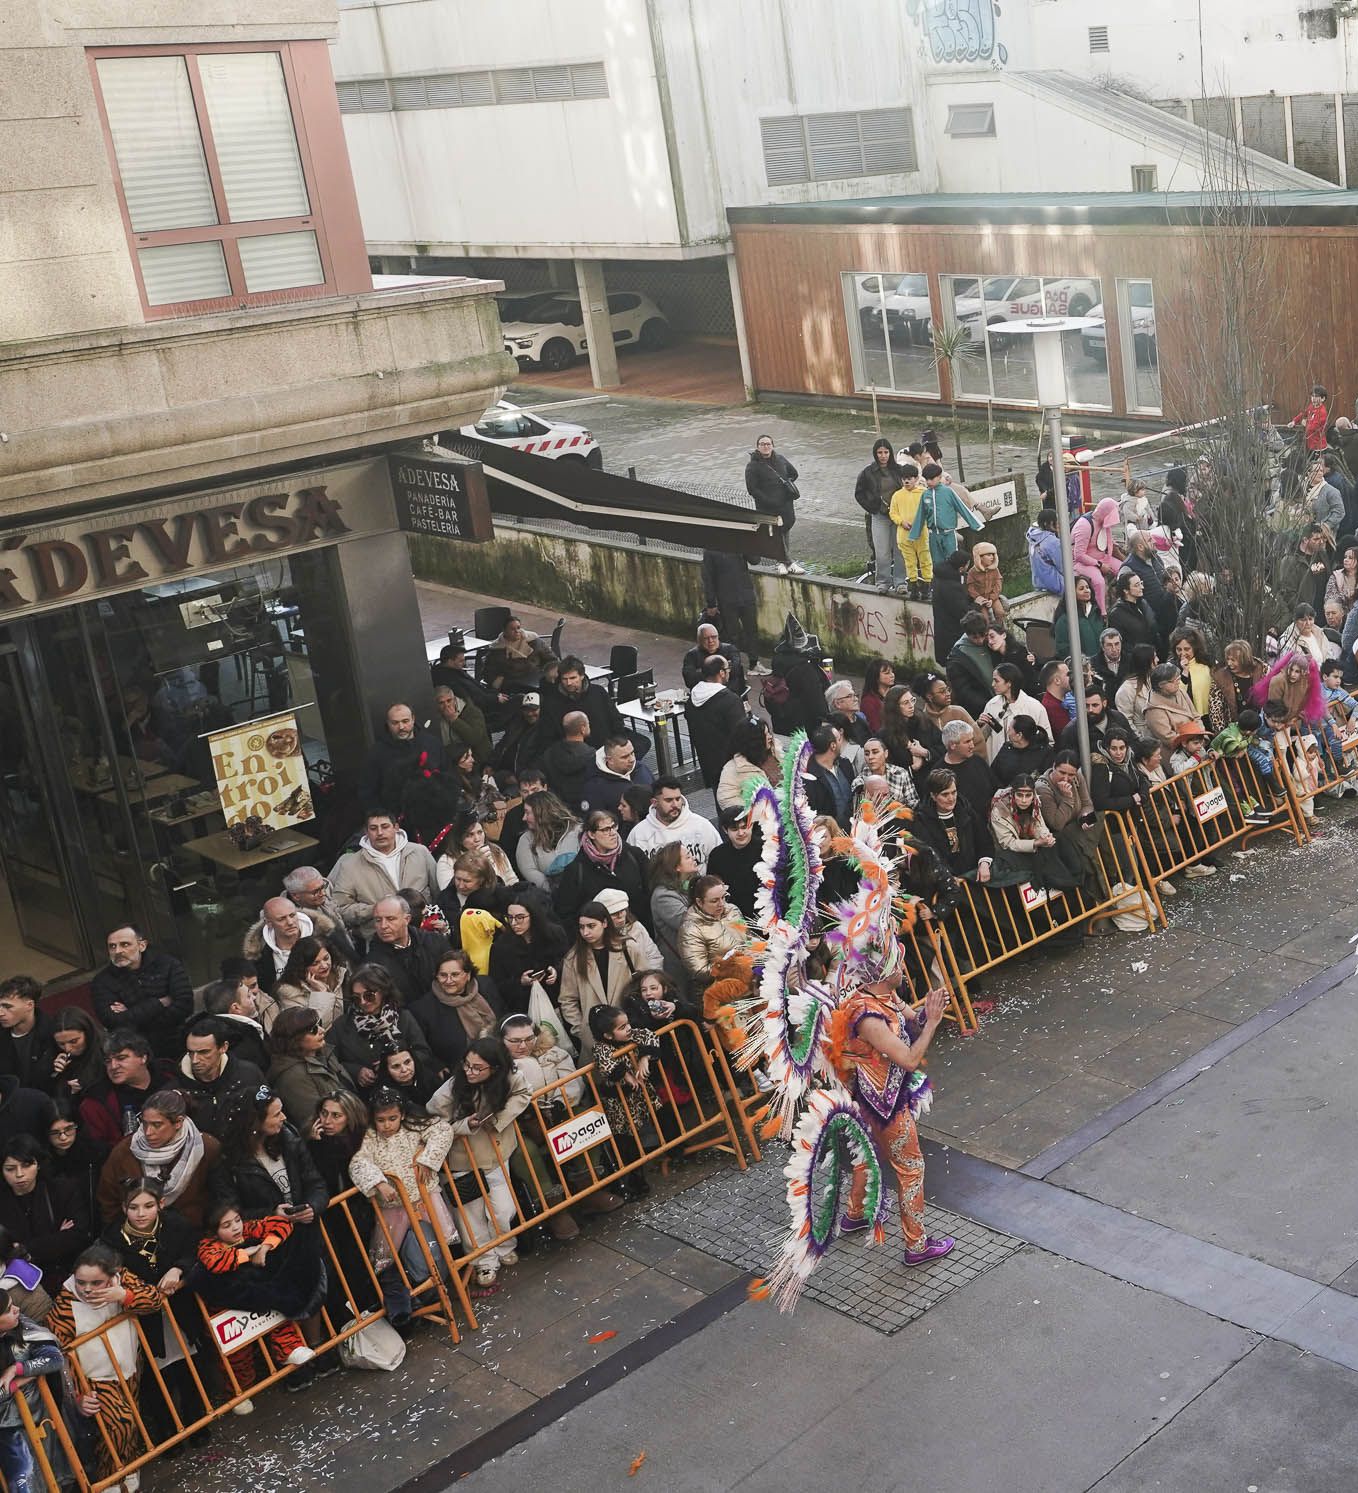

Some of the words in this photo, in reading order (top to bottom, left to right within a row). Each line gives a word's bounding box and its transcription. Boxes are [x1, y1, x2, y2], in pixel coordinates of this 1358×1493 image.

[407, 490, 456, 508] PANADERÍA
[411, 518, 461, 535] PASTELERÍA
[213, 751, 268, 781] En
[220, 761, 293, 808] troi
[552, 1116, 606, 1156] Myagal
